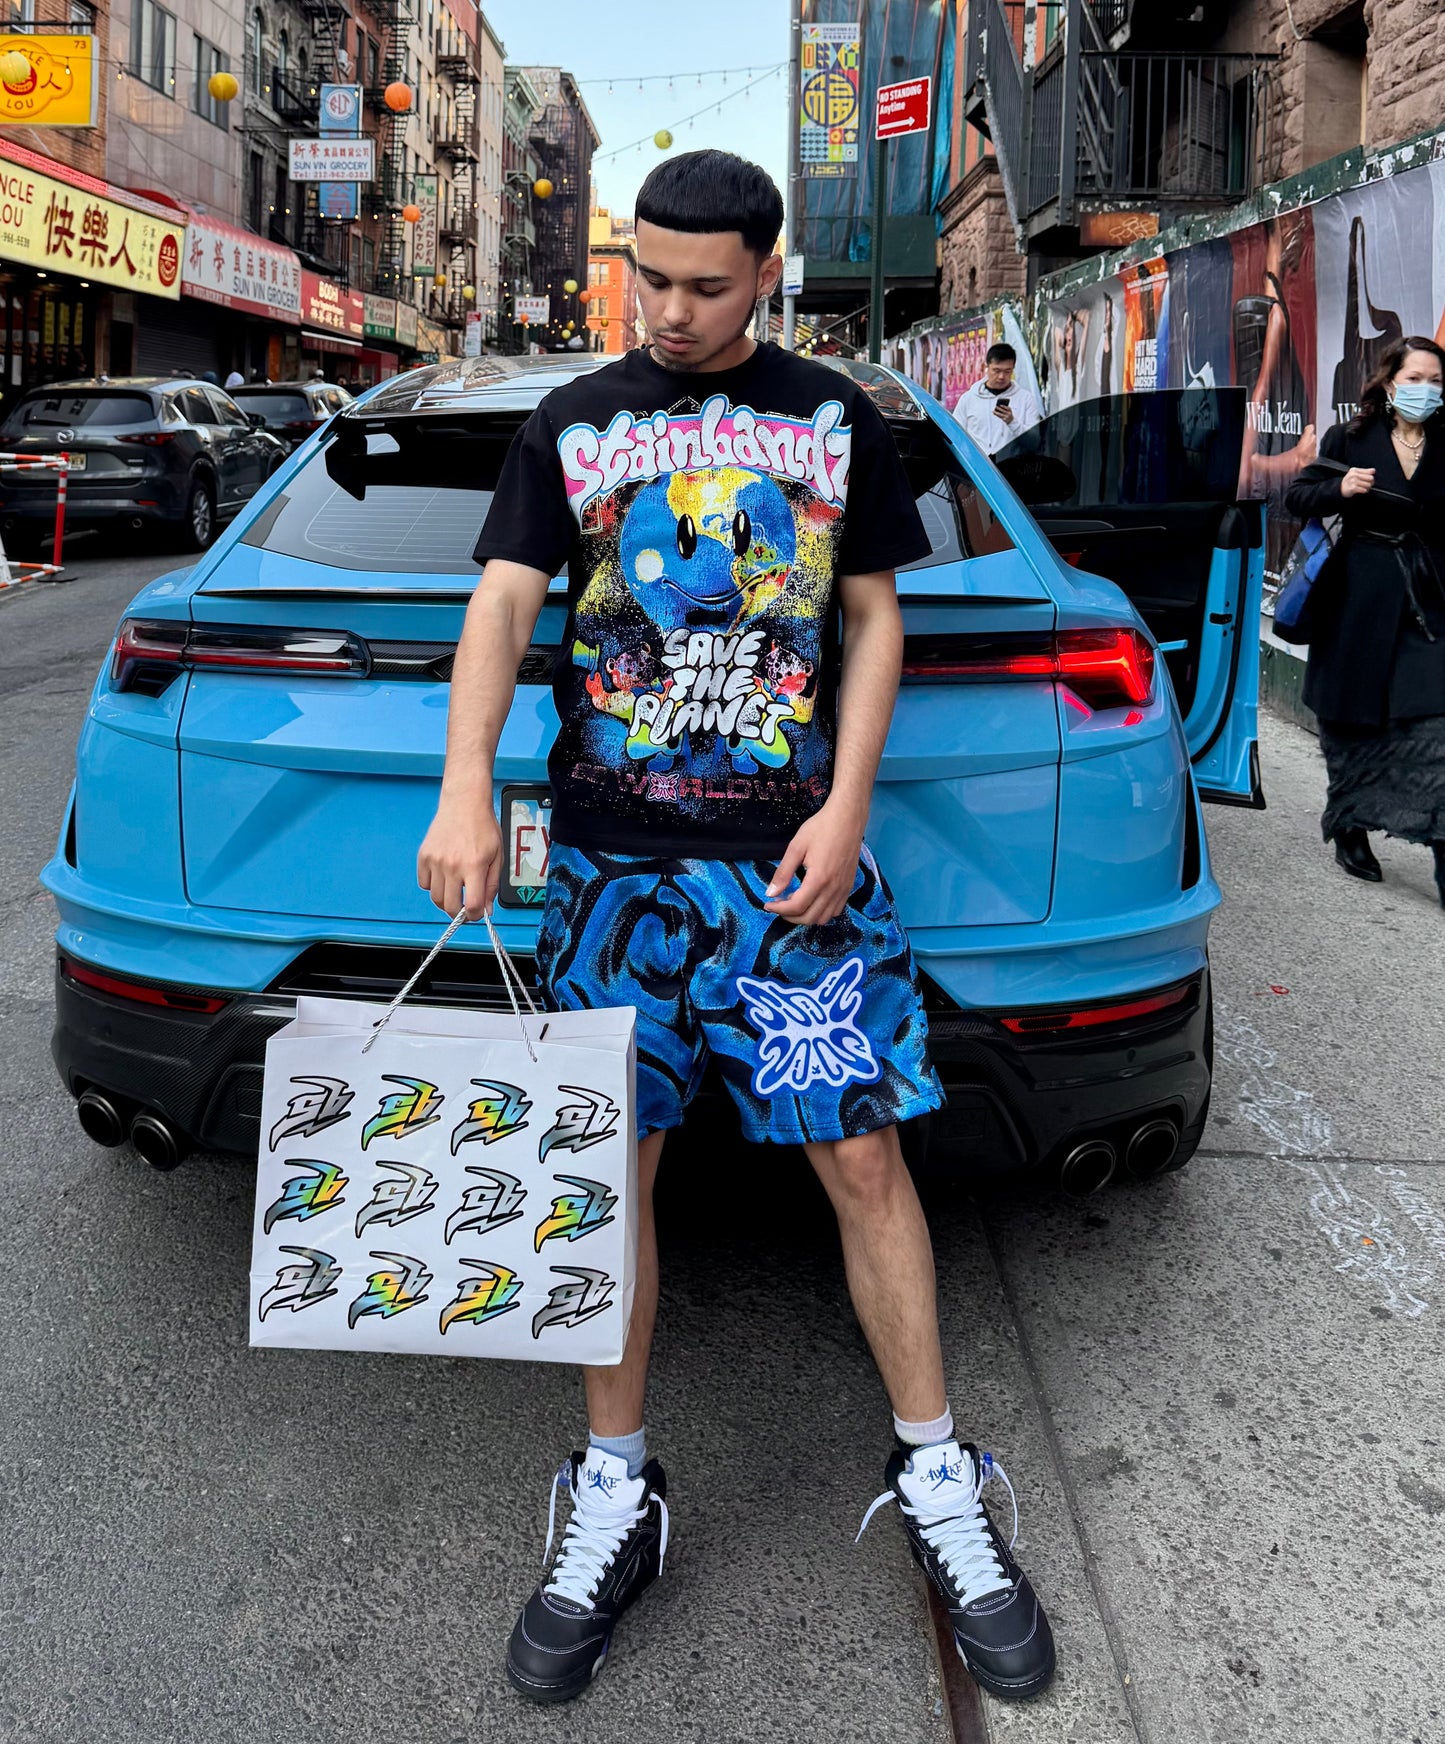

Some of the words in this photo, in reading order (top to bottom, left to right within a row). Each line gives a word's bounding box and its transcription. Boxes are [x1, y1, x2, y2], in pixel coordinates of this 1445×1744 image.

[73, 40, 87, 49] 73
[6, 98, 34, 111] LOU
[879, 91, 889, 103] NO
[889, 84, 923, 101] STANDING
[879, 101, 906, 116] Anytime
[294, 161, 312, 170] SUN
[313, 161, 327, 170] VIN
[330, 161, 369, 170] GROCERY
[0, 171, 35, 204] NCLE
[0, 204, 24, 227] OU
[43, 190, 137, 277] 快樂人
[233, 276, 250, 297] SUN
[252, 281, 266, 301] VIN
[266, 286, 299, 311] GROCERY
[1146, 338, 1158, 356] ME
[1134, 356, 1158, 376] HARD
[1246, 399, 1273, 434] With
[1274, 400, 1302, 436] Jéan
[660, 628, 766, 669] SAVE
[669, 666, 756, 702] THE
[630, 694, 795, 745] PLANET
[583, 1467, 622, 1490] AWKE
[919, 1459, 963, 1483] AWKE
